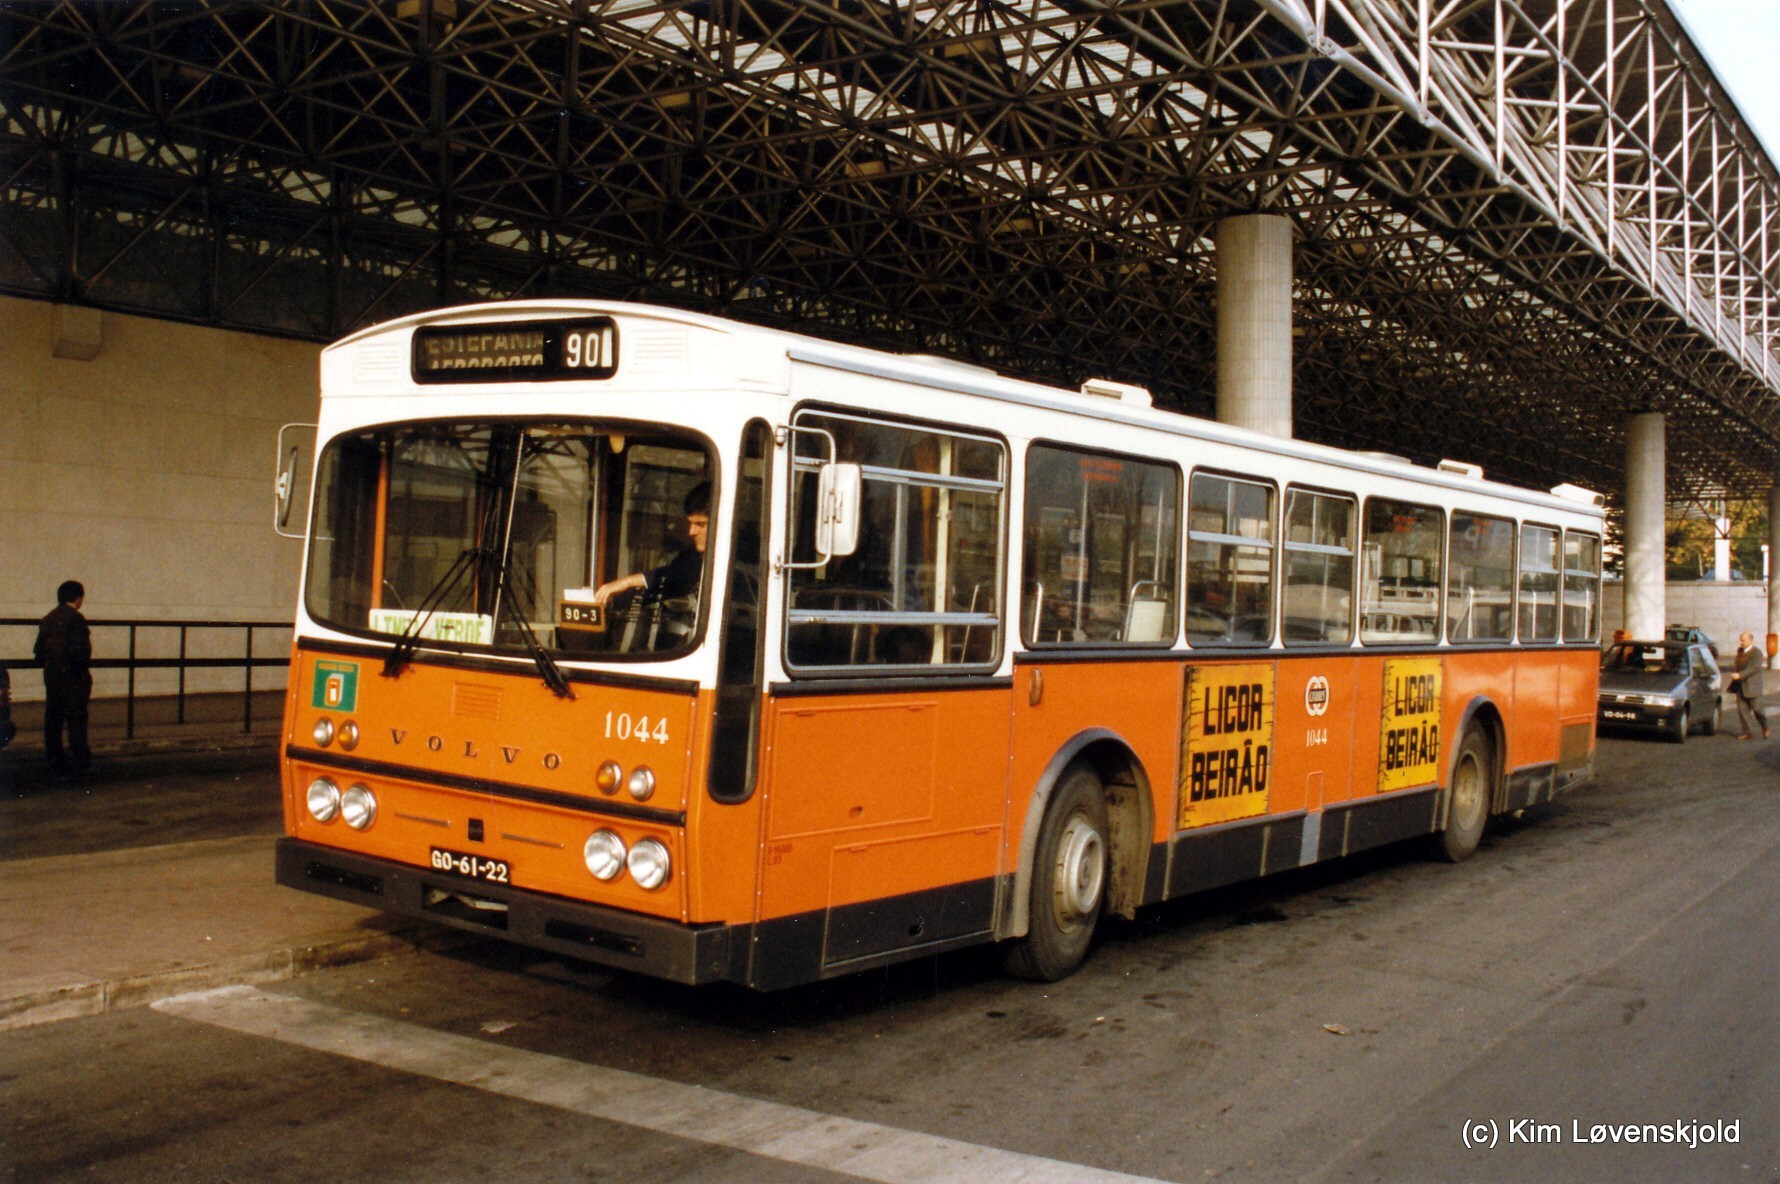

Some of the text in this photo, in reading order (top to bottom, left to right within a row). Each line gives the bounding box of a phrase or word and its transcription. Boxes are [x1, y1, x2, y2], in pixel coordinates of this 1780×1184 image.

[564, 606, 598, 622] 90-3
[1203, 683, 1264, 736] LICOR
[1395, 674, 1435, 717] LICOR
[389, 727, 562, 770] VOLVO
[604, 710, 670, 745] 1044
[1305, 728, 1328, 747] 1044
[1386, 720, 1439, 771] BEIRÃO
[1190, 738, 1269, 803] BEIRÃO
[430, 849, 509, 884] GO-61-22
